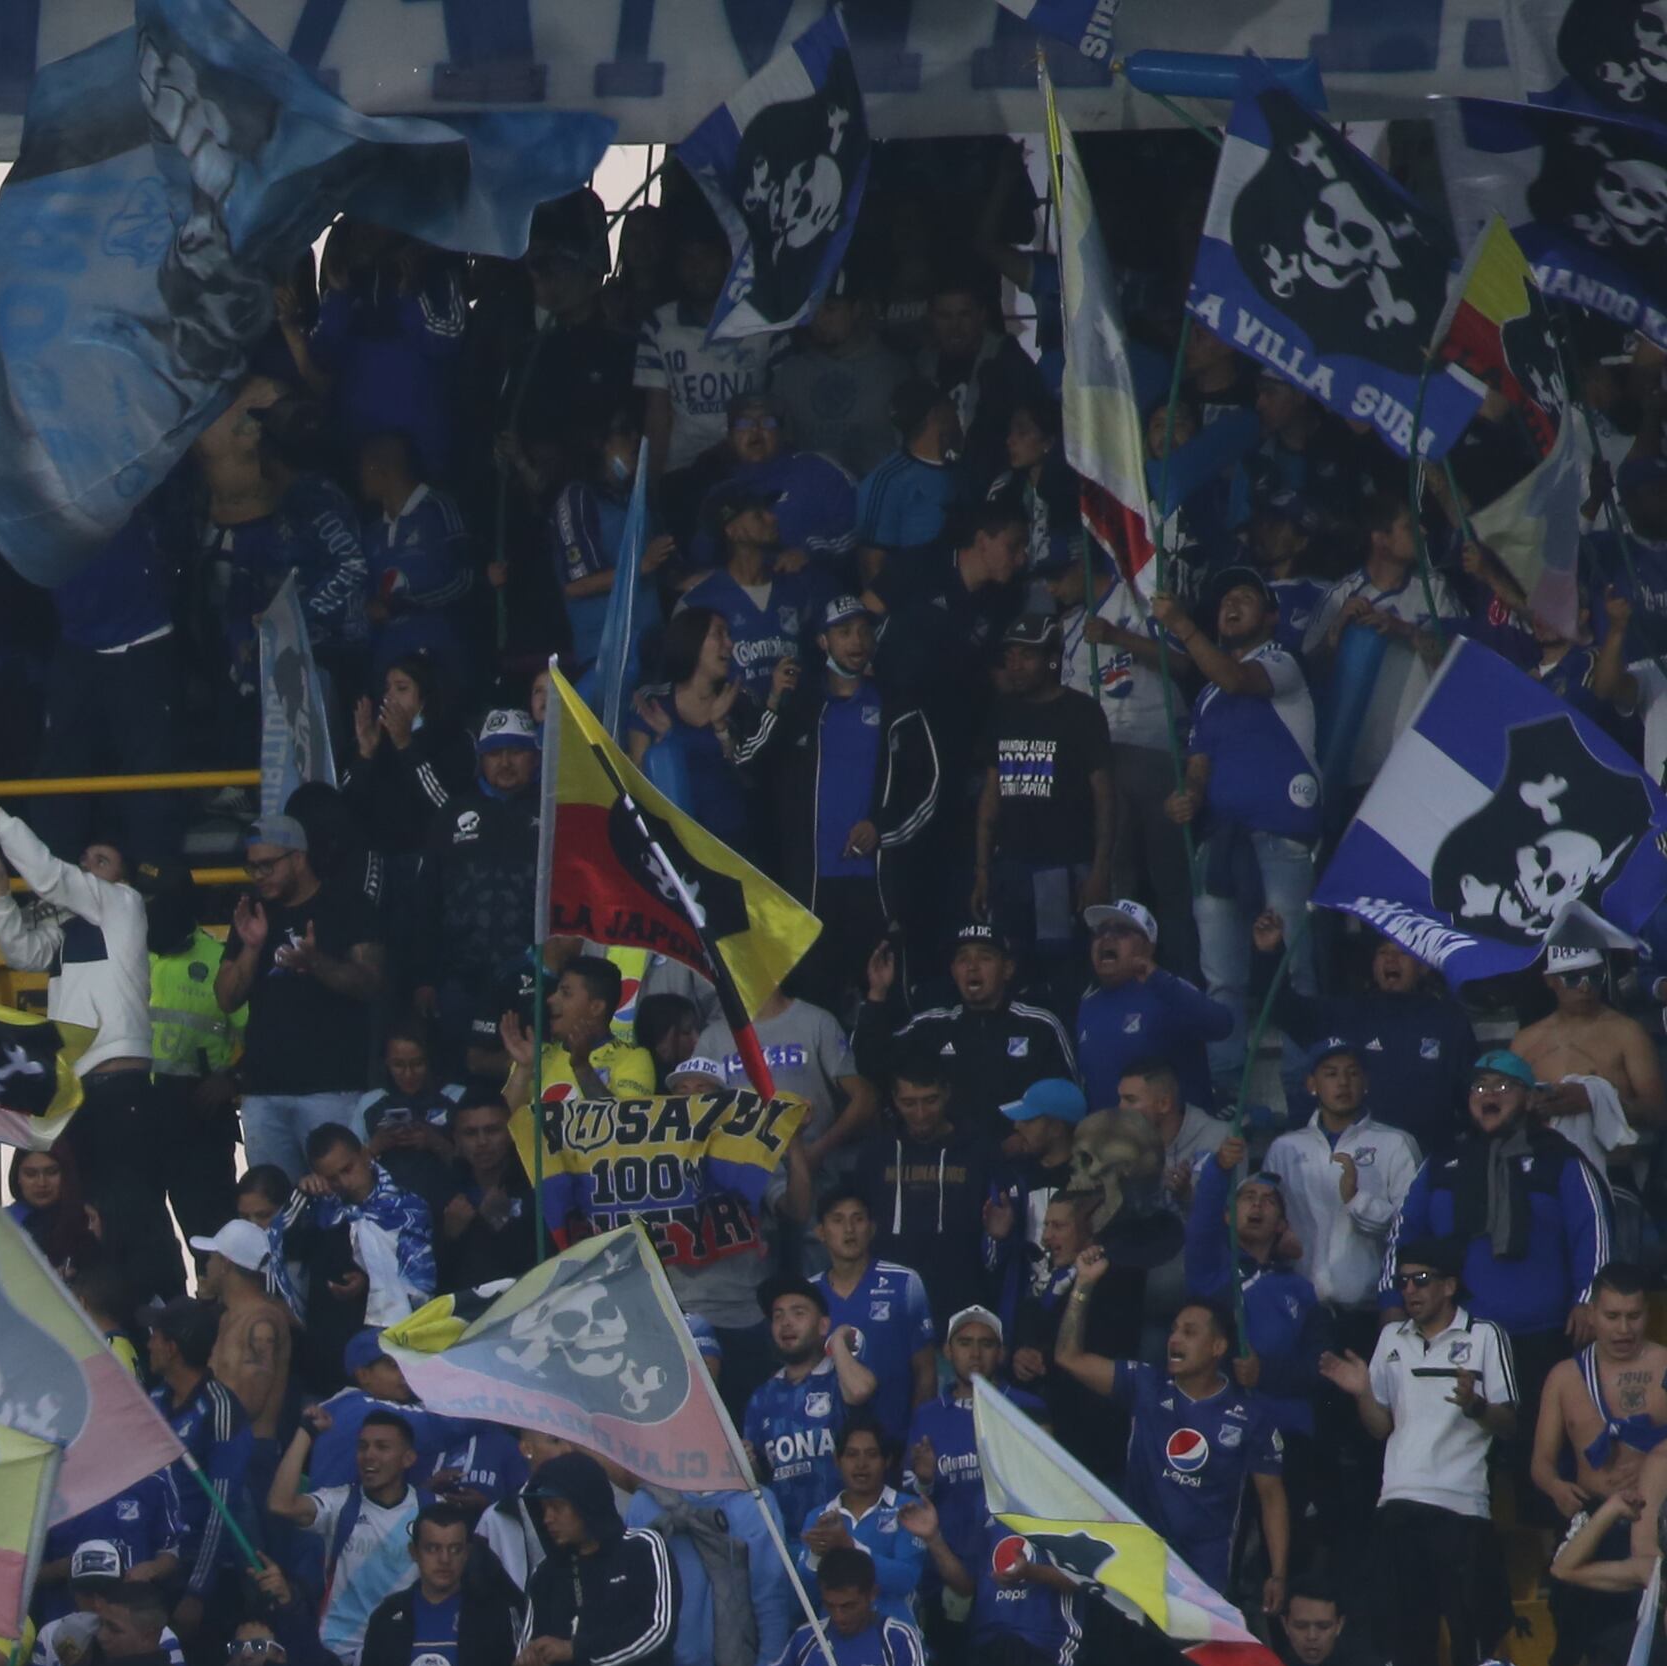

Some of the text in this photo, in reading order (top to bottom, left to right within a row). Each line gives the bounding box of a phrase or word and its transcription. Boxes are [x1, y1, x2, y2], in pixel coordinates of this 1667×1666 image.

[1231, 307, 1335, 402] VILLA
[552, 904, 592, 932] LA
[1162, 1467, 1202, 1489] pepsi
